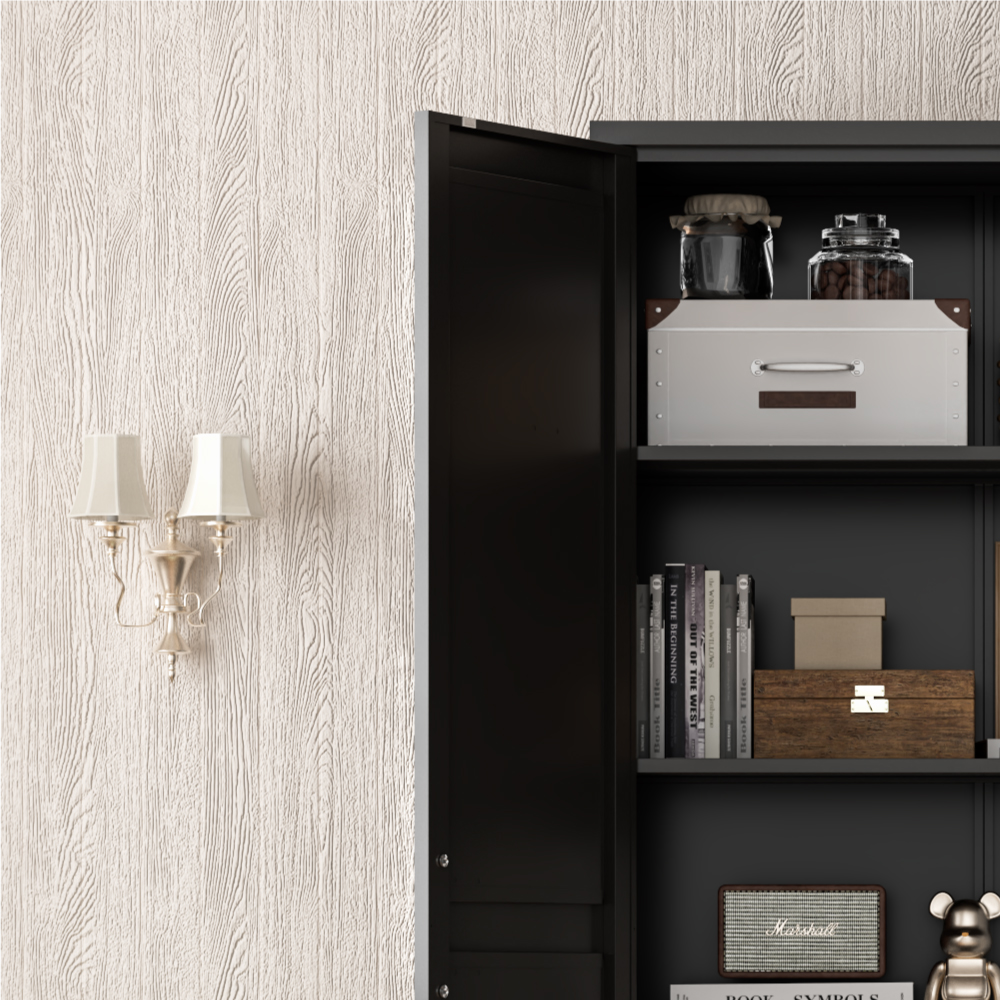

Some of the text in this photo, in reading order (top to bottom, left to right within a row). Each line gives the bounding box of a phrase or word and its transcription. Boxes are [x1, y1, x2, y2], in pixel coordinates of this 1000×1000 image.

[670, 584, 677, 597] IN
[690, 651, 697, 665] OF
[766, 918, 839, 937] Marshall
